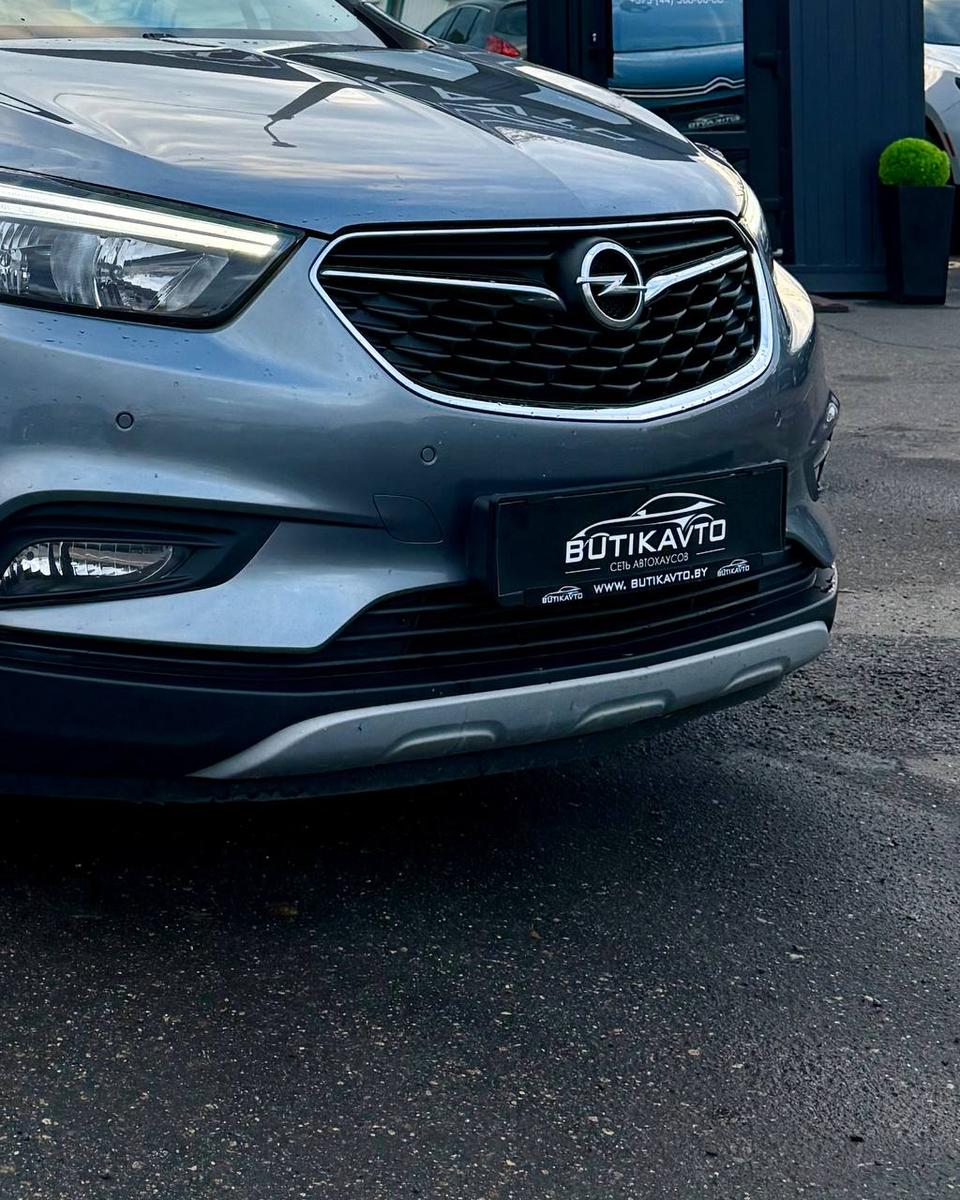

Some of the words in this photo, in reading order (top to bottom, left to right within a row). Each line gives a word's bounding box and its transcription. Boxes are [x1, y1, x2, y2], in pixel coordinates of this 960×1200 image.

[565, 518, 727, 563] BUTIKAVTO
[609, 560, 631, 572] СЕТЬ
[633, 552, 689, 568] АВТОХАУСОВ
[593, 581, 627, 594] WWW.
[631, 567, 708, 589] BUTIKAVTO.BY
[541, 592, 583, 604] BUTIKAVTO
